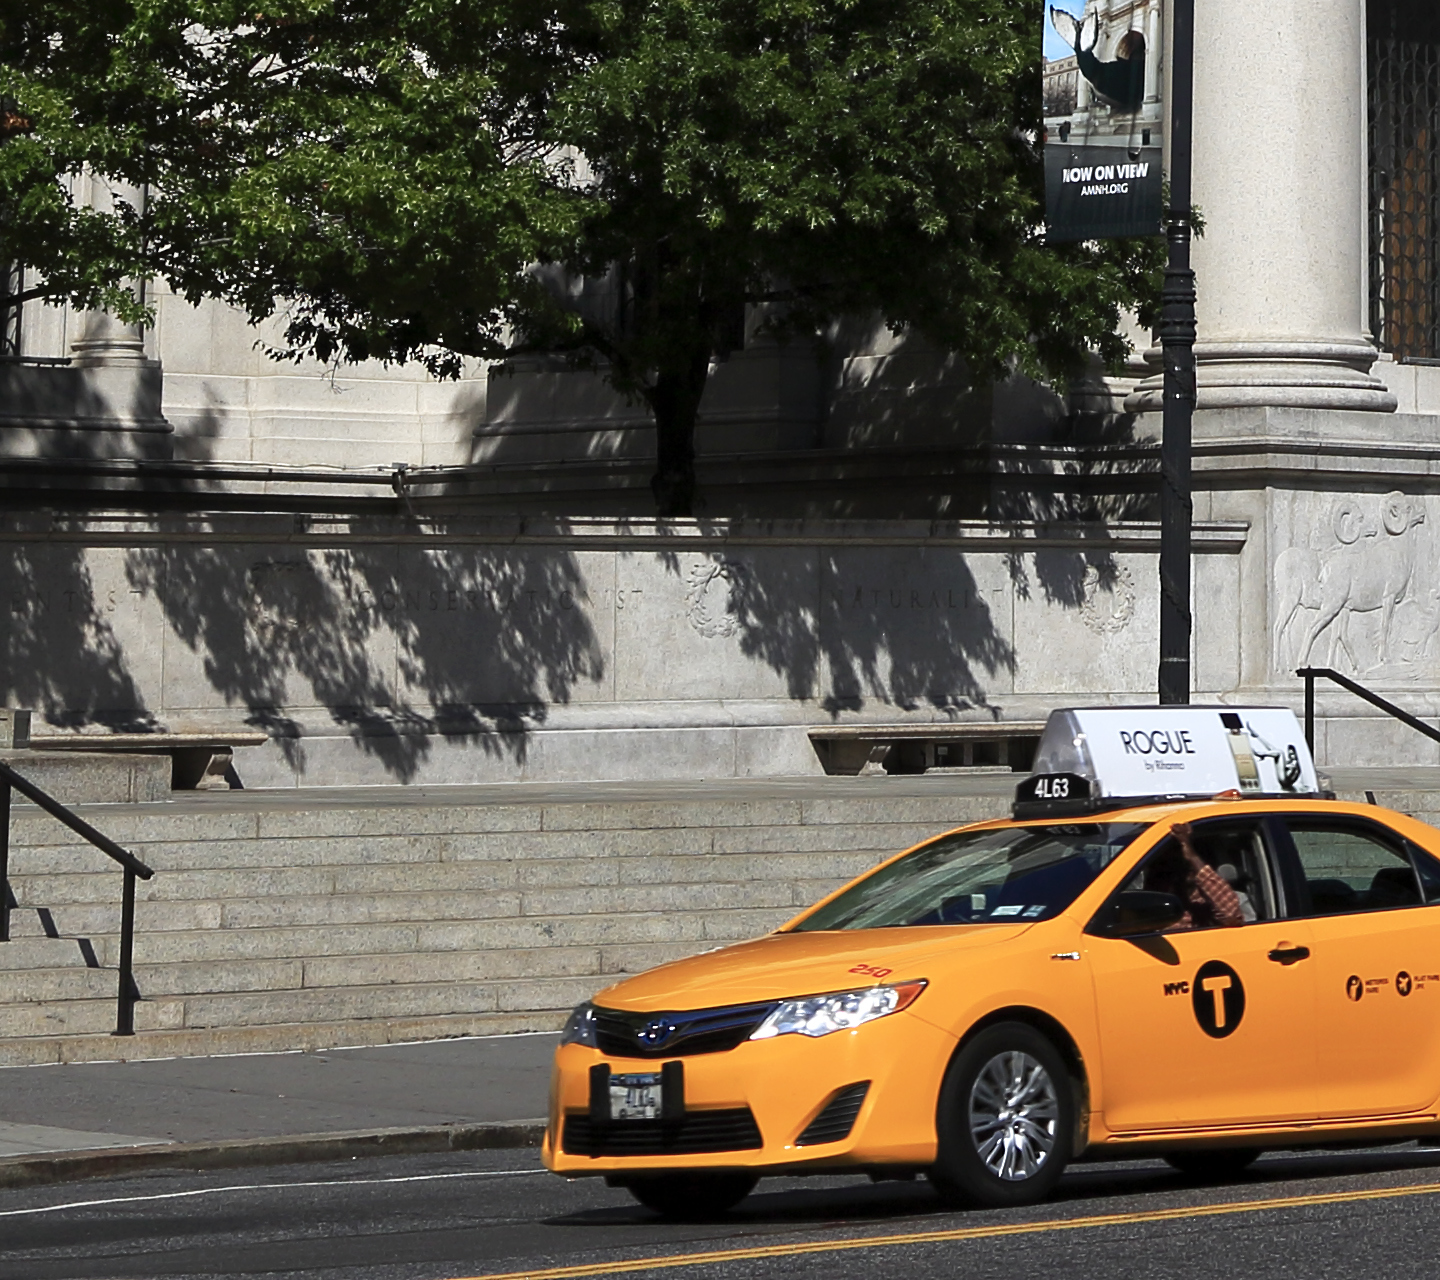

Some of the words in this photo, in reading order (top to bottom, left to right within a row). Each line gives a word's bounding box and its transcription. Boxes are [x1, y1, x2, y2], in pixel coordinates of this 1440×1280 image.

[1062, 166, 1093, 183] NOW
[1094, 165, 1115, 181] ON
[1116, 162, 1149, 179] VIEW
[357, 590, 644, 611] CONSERVATIONIST
[828, 588, 1003, 609] NATURALIST
[1120, 730, 1195, 755] ROGUE
[1034, 778, 1070, 798] 4L63
[1163, 981, 1190, 996] NYC
[1202, 976, 1232, 1028] T
